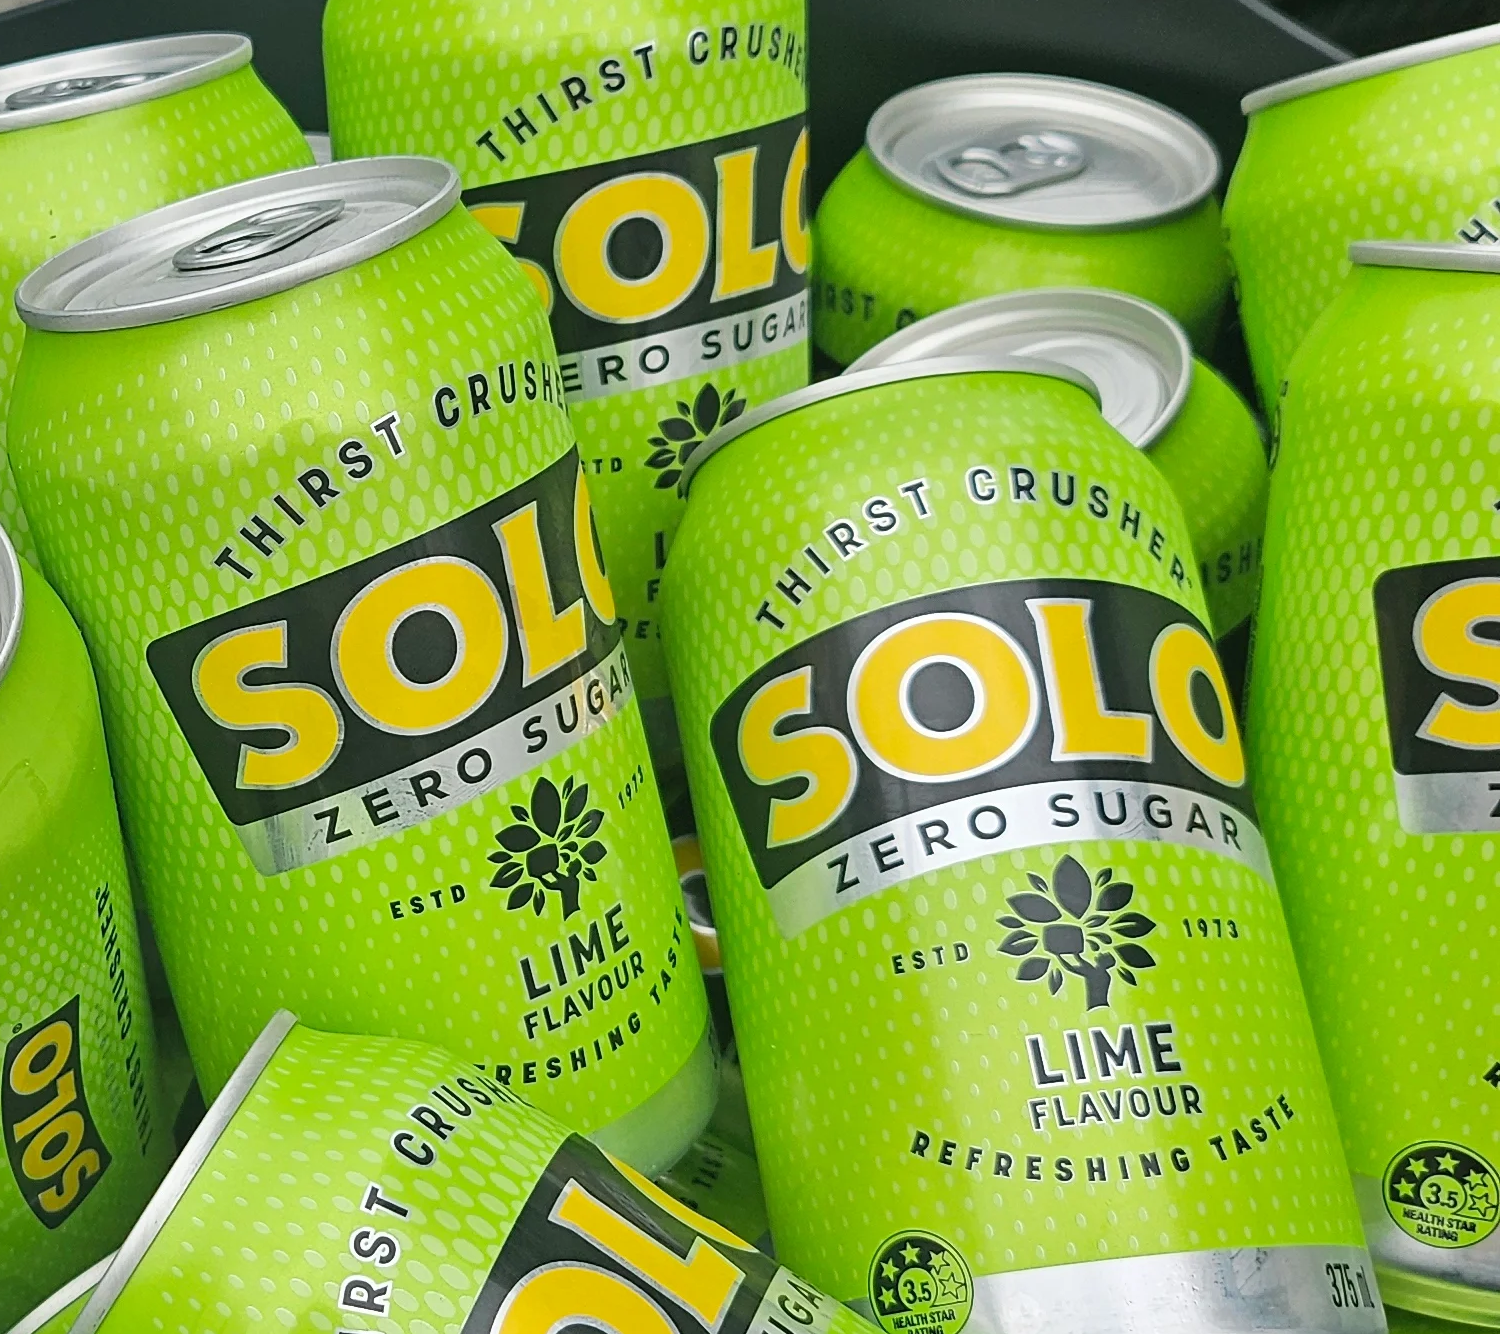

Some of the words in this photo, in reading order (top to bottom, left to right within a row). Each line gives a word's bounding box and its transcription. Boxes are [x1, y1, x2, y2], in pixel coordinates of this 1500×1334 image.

[475, 40, 657, 165] THIRST
[688, 24, 806, 85] CRUSHE
[560, 343, 671, 393] ERO
[213, 412, 405, 580] THIRST
[434, 359, 567, 429] CRUSHE
[581, 456, 623, 476] STD
[755, 478, 933, 633] THIRST
[965, 466, 1186, 591] CRUSHER
[314, 747, 492, 844] ZERO
[523, 649, 632, 754] SUGAR
[738, 596, 1247, 849] SOLO
[826, 804, 1007, 895] ZERO
[1049, 791, 1242, 852] SUGAR
[390, 884, 467, 920] ESTD
[519, 903, 632, 1000] LIME
[892, 941, 971, 975] ESTD
[1182, 916, 1240, 940] 1973
[474, 1013, 642, 1086] RESHING
[649, 905, 684, 1006] TASTE
[523, 950, 646, 1041] FLAVOUR
[1025, 1021, 1183, 1088] LIME
[8, 1019, 102, 1214] SOLO
[392, 1076, 528, 1167] CRUSH
[909, 1129, 1191, 1184] REFRESHING
[1209, 1093, 1296, 1162] TASTE
[1027, 1083, 1203, 1132] FLAVOUR
[1403, 1207, 1445, 1226] HEALTH
[1447, 1217, 1477, 1234] STAR
[1416, 1222, 1459, 1243] RATING
[1426, 1182, 1458, 1210] 3.5
[892, 1313, 928, 1330] HEALTH
[929, 1309, 956, 1323] STAR
[903, 1278, 932, 1305] 3.5
[1325, 1261, 1359, 1310] 375
